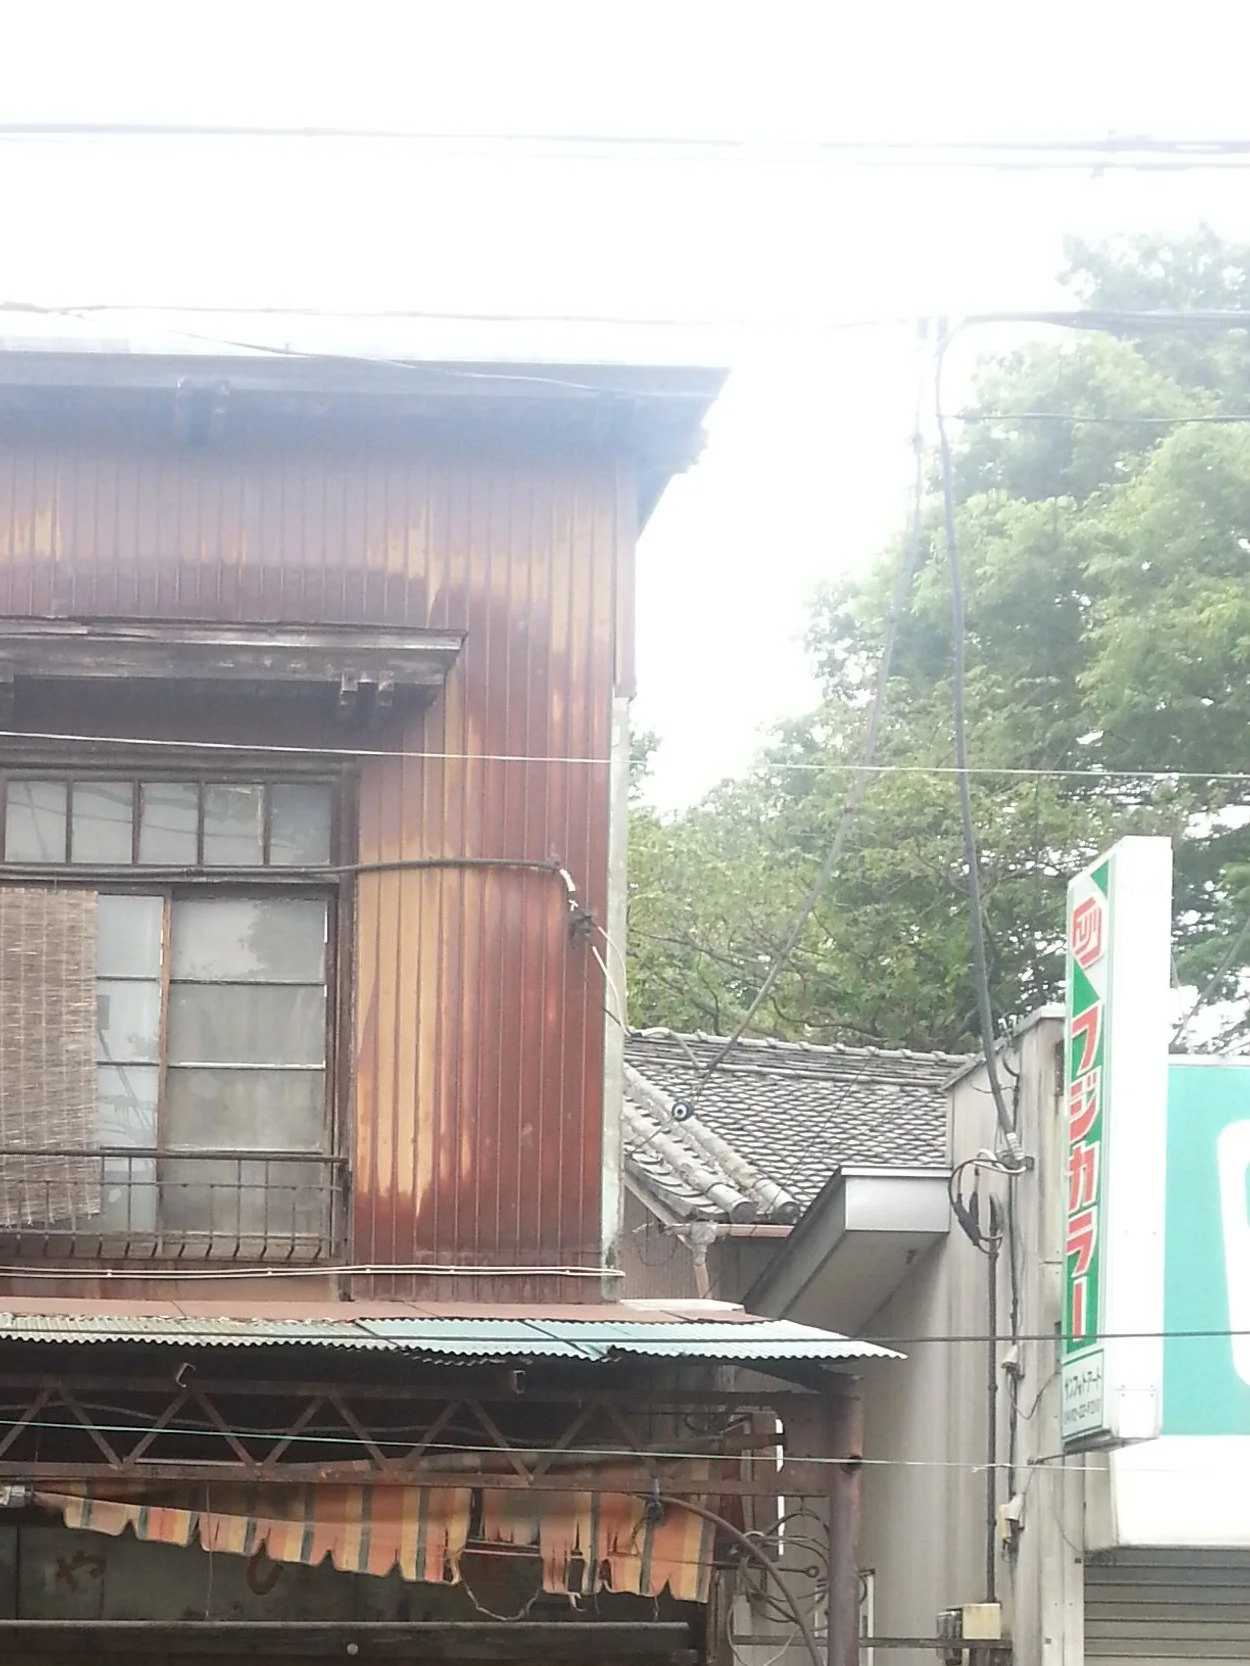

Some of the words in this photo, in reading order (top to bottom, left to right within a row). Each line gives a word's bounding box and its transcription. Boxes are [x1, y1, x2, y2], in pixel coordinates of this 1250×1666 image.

[1067, 1002, 1100, 1338] フジカラー
